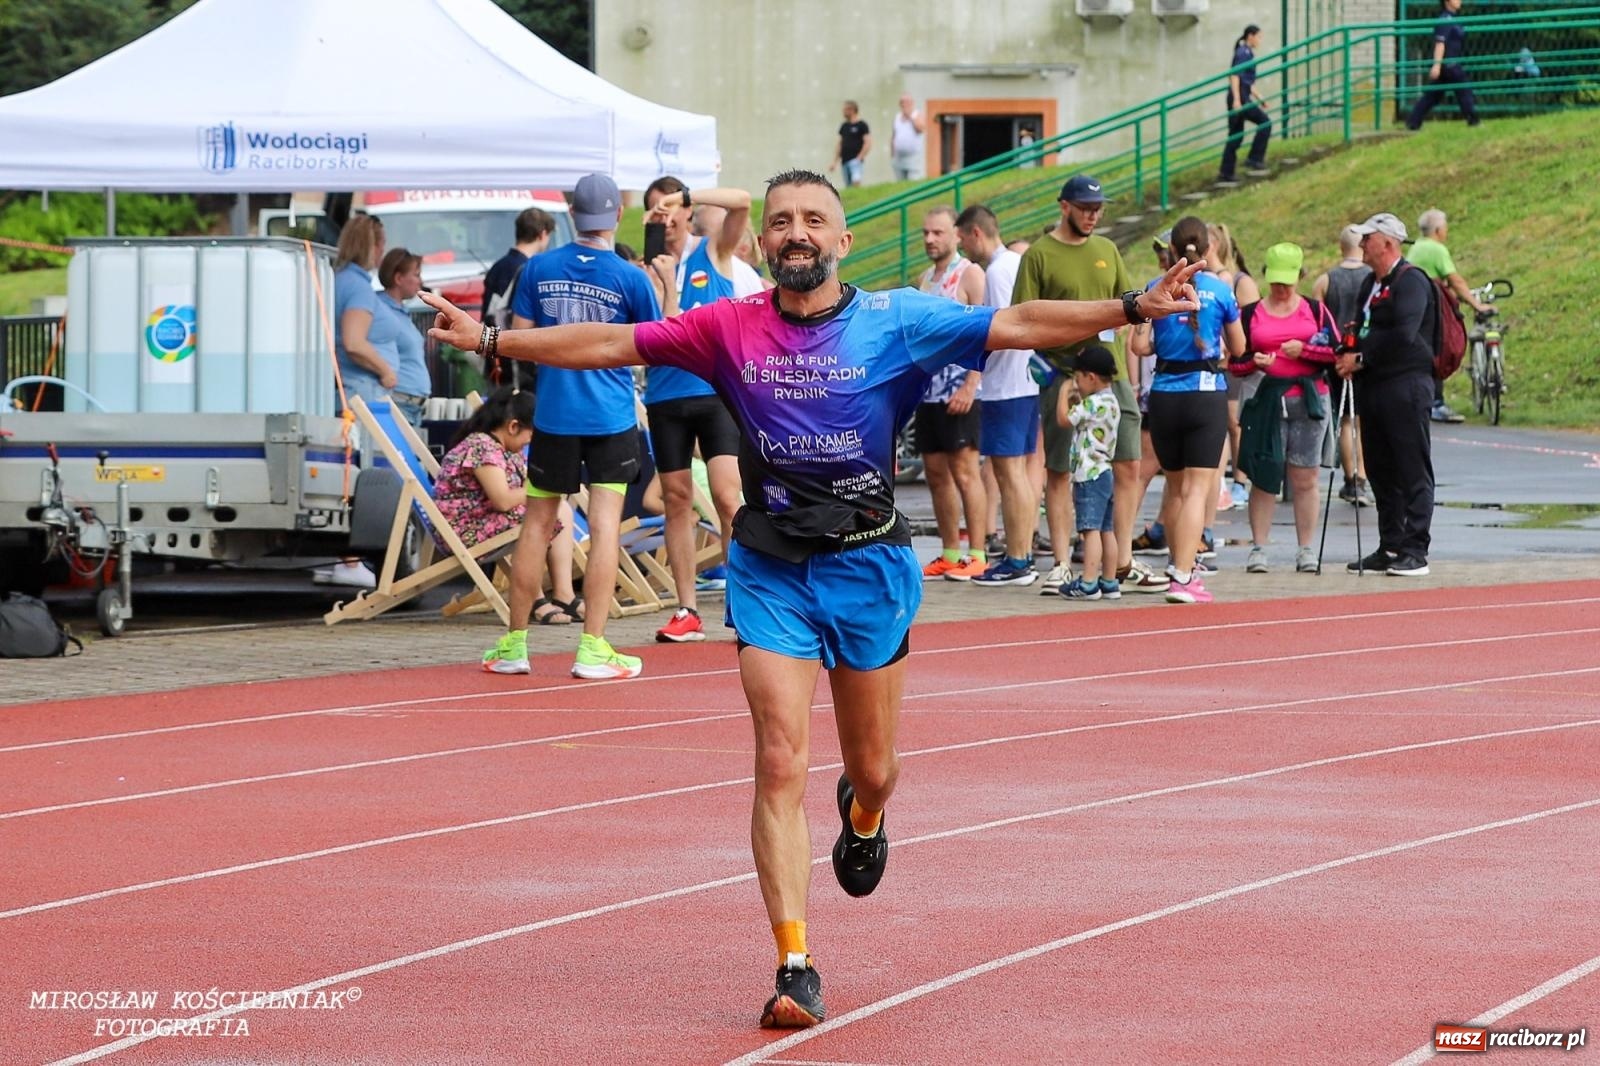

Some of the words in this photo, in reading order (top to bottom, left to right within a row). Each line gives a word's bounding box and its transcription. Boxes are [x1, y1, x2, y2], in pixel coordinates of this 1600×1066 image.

[247, 132, 368, 154] Wodociągi
[249, 154, 368, 169] Raciborskie
[537, 283, 570, 294] SILESIA
[571, 284, 621, 305] MARATHON
[765, 355, 793, 367] RUN
[795, 354, 805, 366] &
[808, 355, 838, 367] FUN
[760, 369, 823, 384] SILESIA
[827, 366, 866, 381] ADM
[774, 387, 829, 400] RYBNIK
[788, 435, 812, 450] PW
[815, 429, 863, 450] KAMEL
